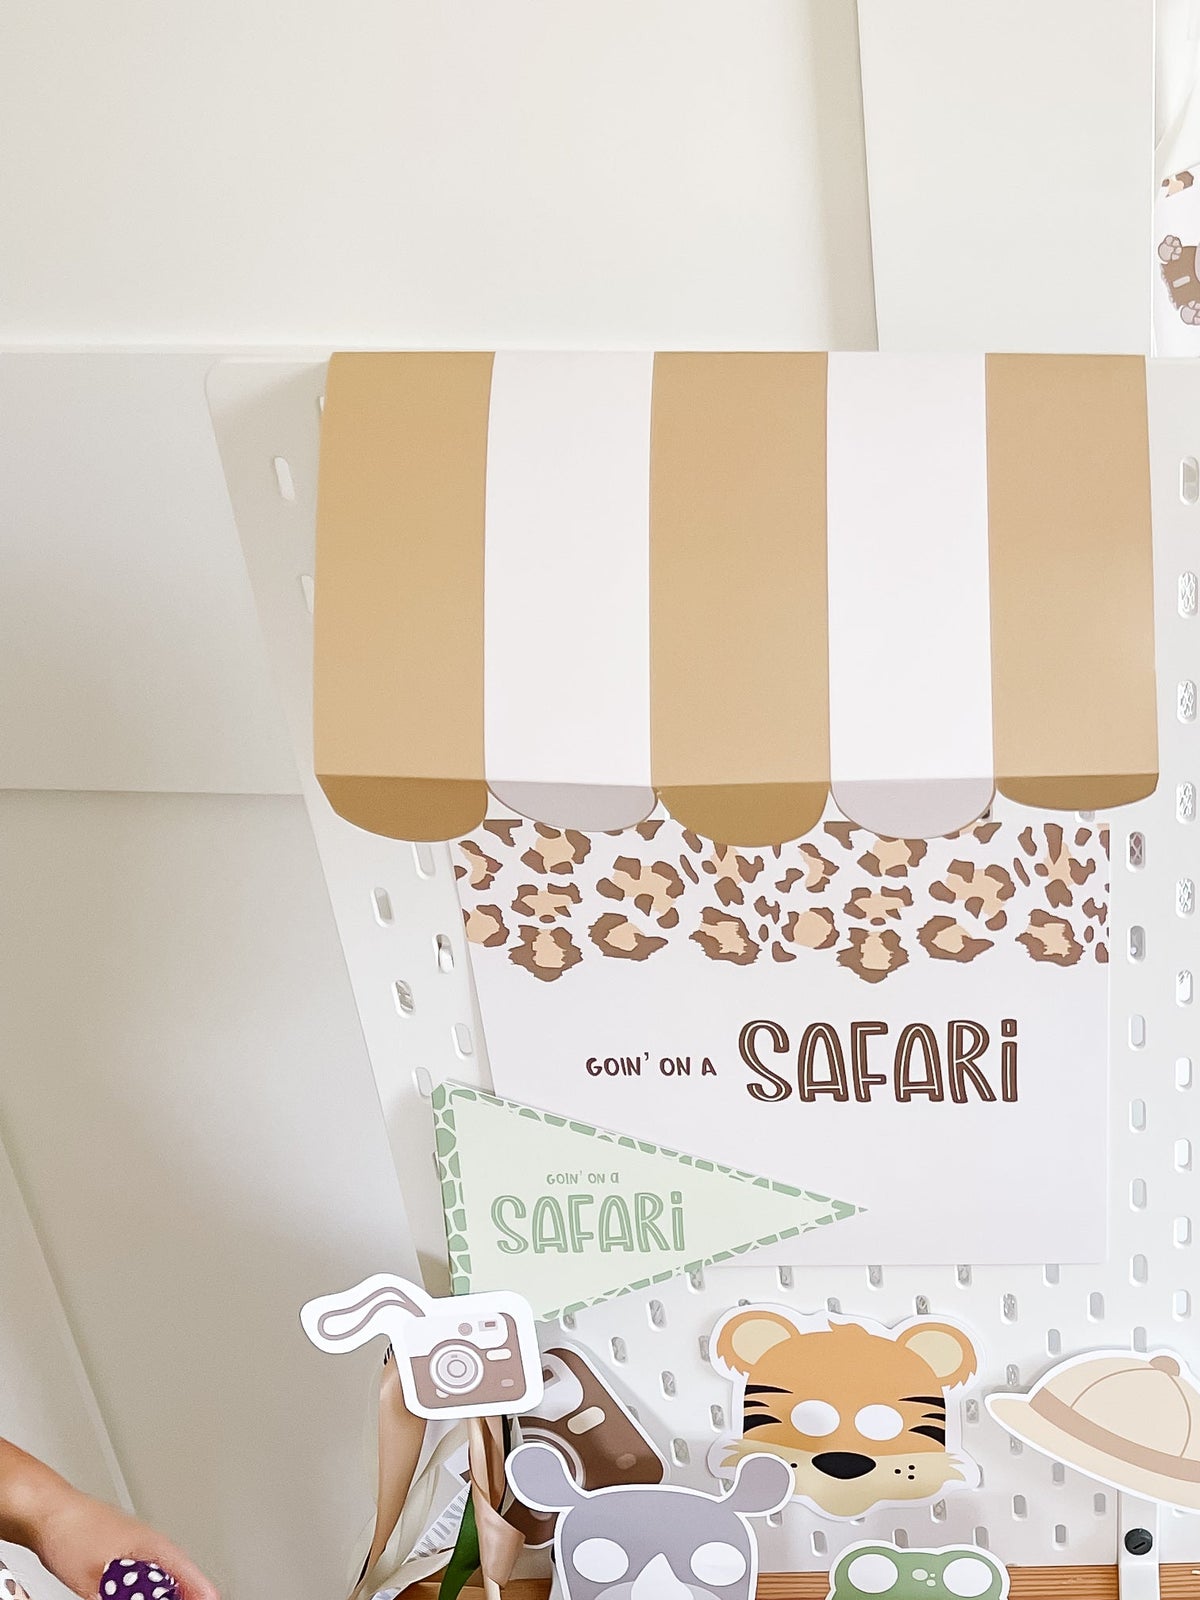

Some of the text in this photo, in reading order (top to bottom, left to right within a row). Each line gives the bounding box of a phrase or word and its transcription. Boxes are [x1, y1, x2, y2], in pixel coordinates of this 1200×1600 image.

[586, 1052, 650, 1077] GOIN'
[660, 1057, 691, 1077] ON
[701, 1057, 718, 1077] A
[546, 1170, 582, 1185] GOIN'
[587, 1172, 605, 1184] ON
